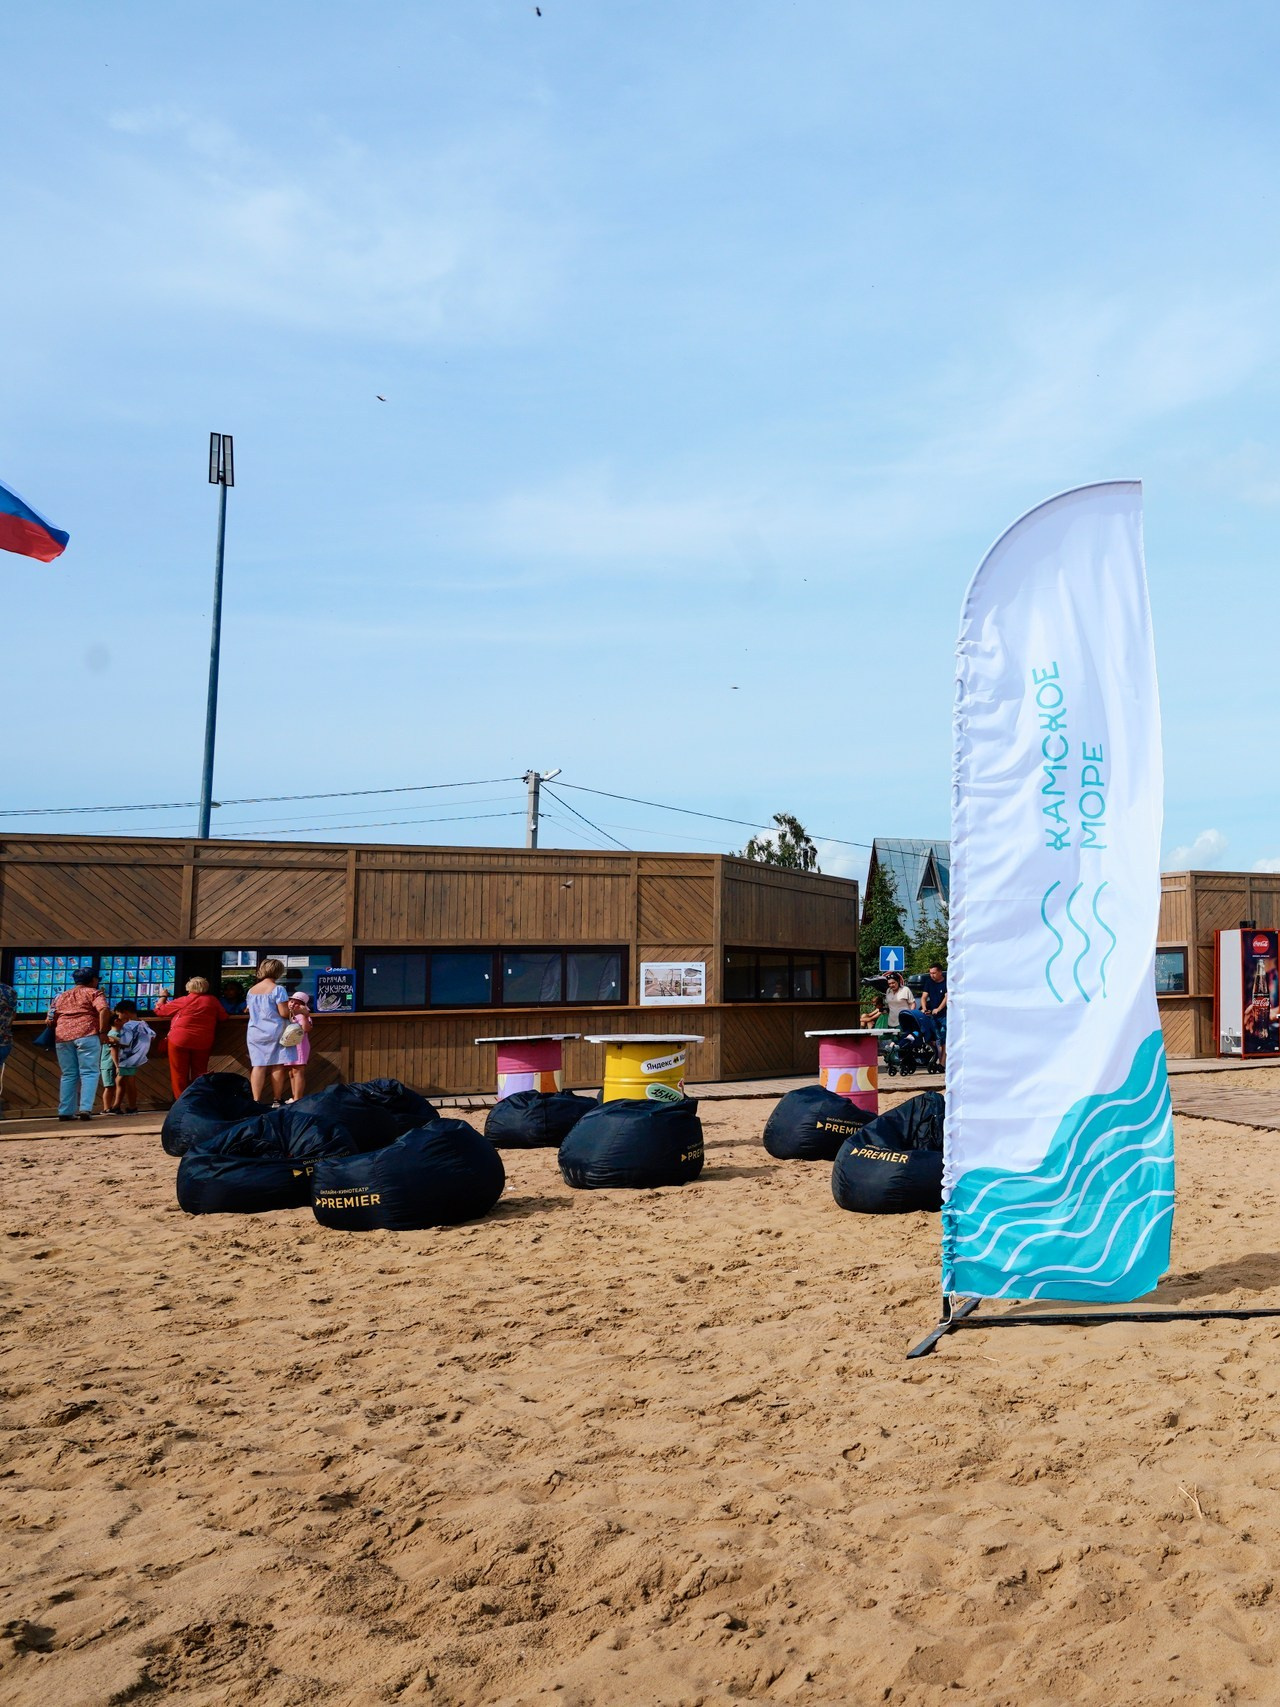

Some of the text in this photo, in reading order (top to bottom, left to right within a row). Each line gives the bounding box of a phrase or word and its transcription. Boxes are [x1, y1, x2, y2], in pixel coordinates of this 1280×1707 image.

[1031, 660, 1073, 852] КАМСКОЕ
[1078, 740, 1109, 851] МОРЕ
[318, 976, 347, 984] ГОРЯЧАЯ
[646, 1060, 673, 1071] Яндекс
[824, 1122, 861, 1135] PREMI
[857, 1148, 909, 1165] PREMIER
[321, 1193, 381, 1209] PREMIER
